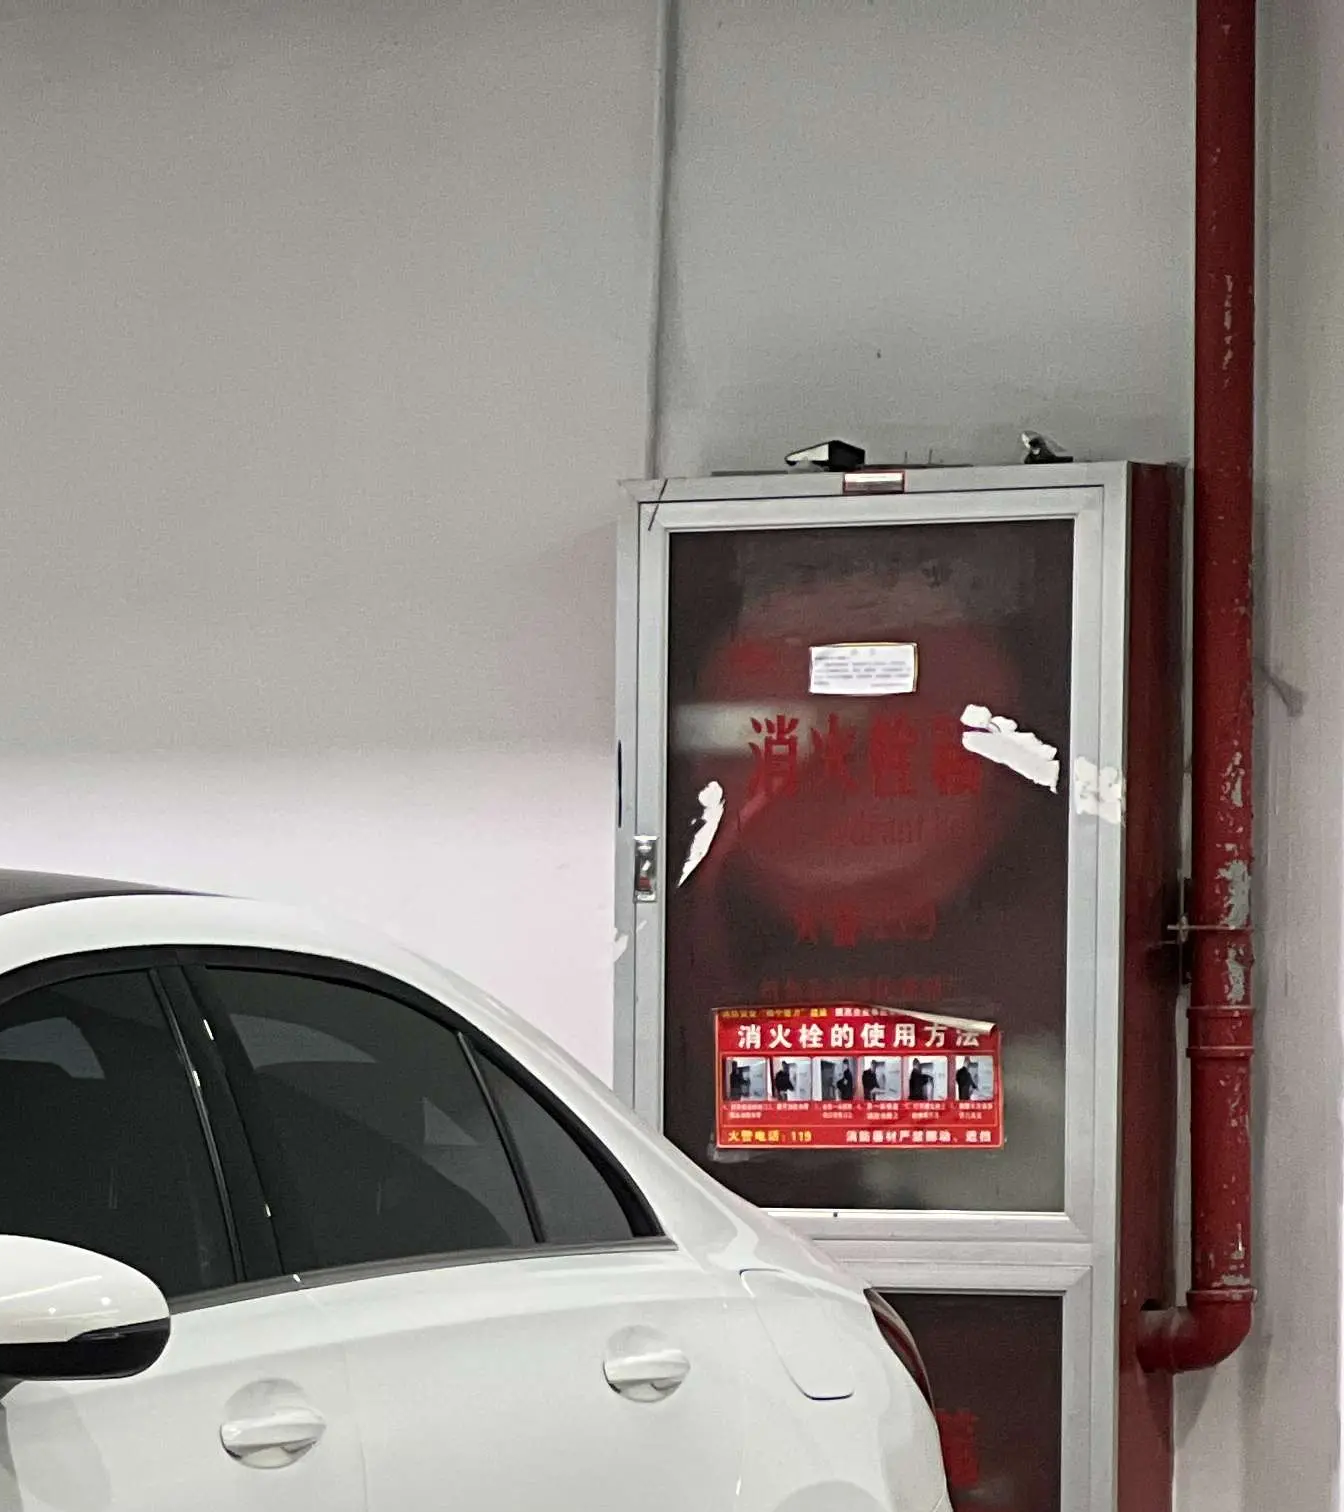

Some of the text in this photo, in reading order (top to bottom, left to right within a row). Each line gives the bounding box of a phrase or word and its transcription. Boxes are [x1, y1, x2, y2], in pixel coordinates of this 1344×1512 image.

[737, 1023, 980, 1049] 消火栓的使用方法
